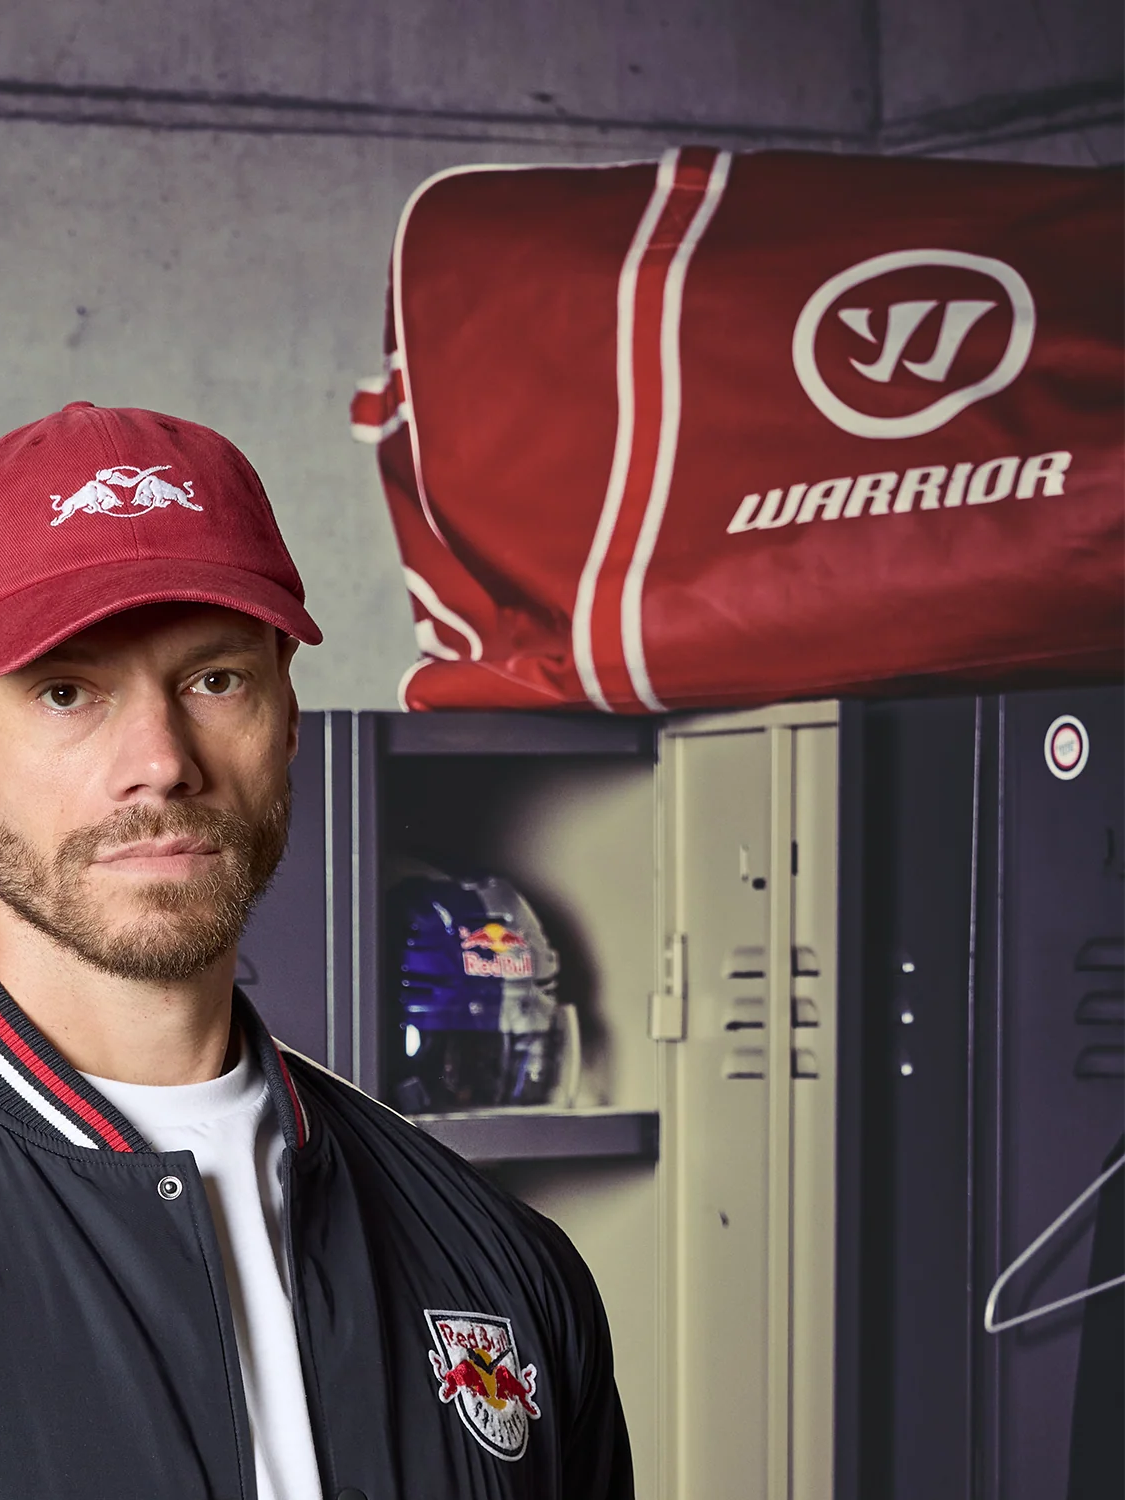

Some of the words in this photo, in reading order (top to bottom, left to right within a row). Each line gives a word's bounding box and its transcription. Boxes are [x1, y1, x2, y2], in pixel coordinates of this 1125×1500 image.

[725, 450, 1074, 535] WARRIOR
[462, 951, 501, 977] Red
[439, 1322, 479, 1349] Red
[475, 1324, 509, 1353] Bull
